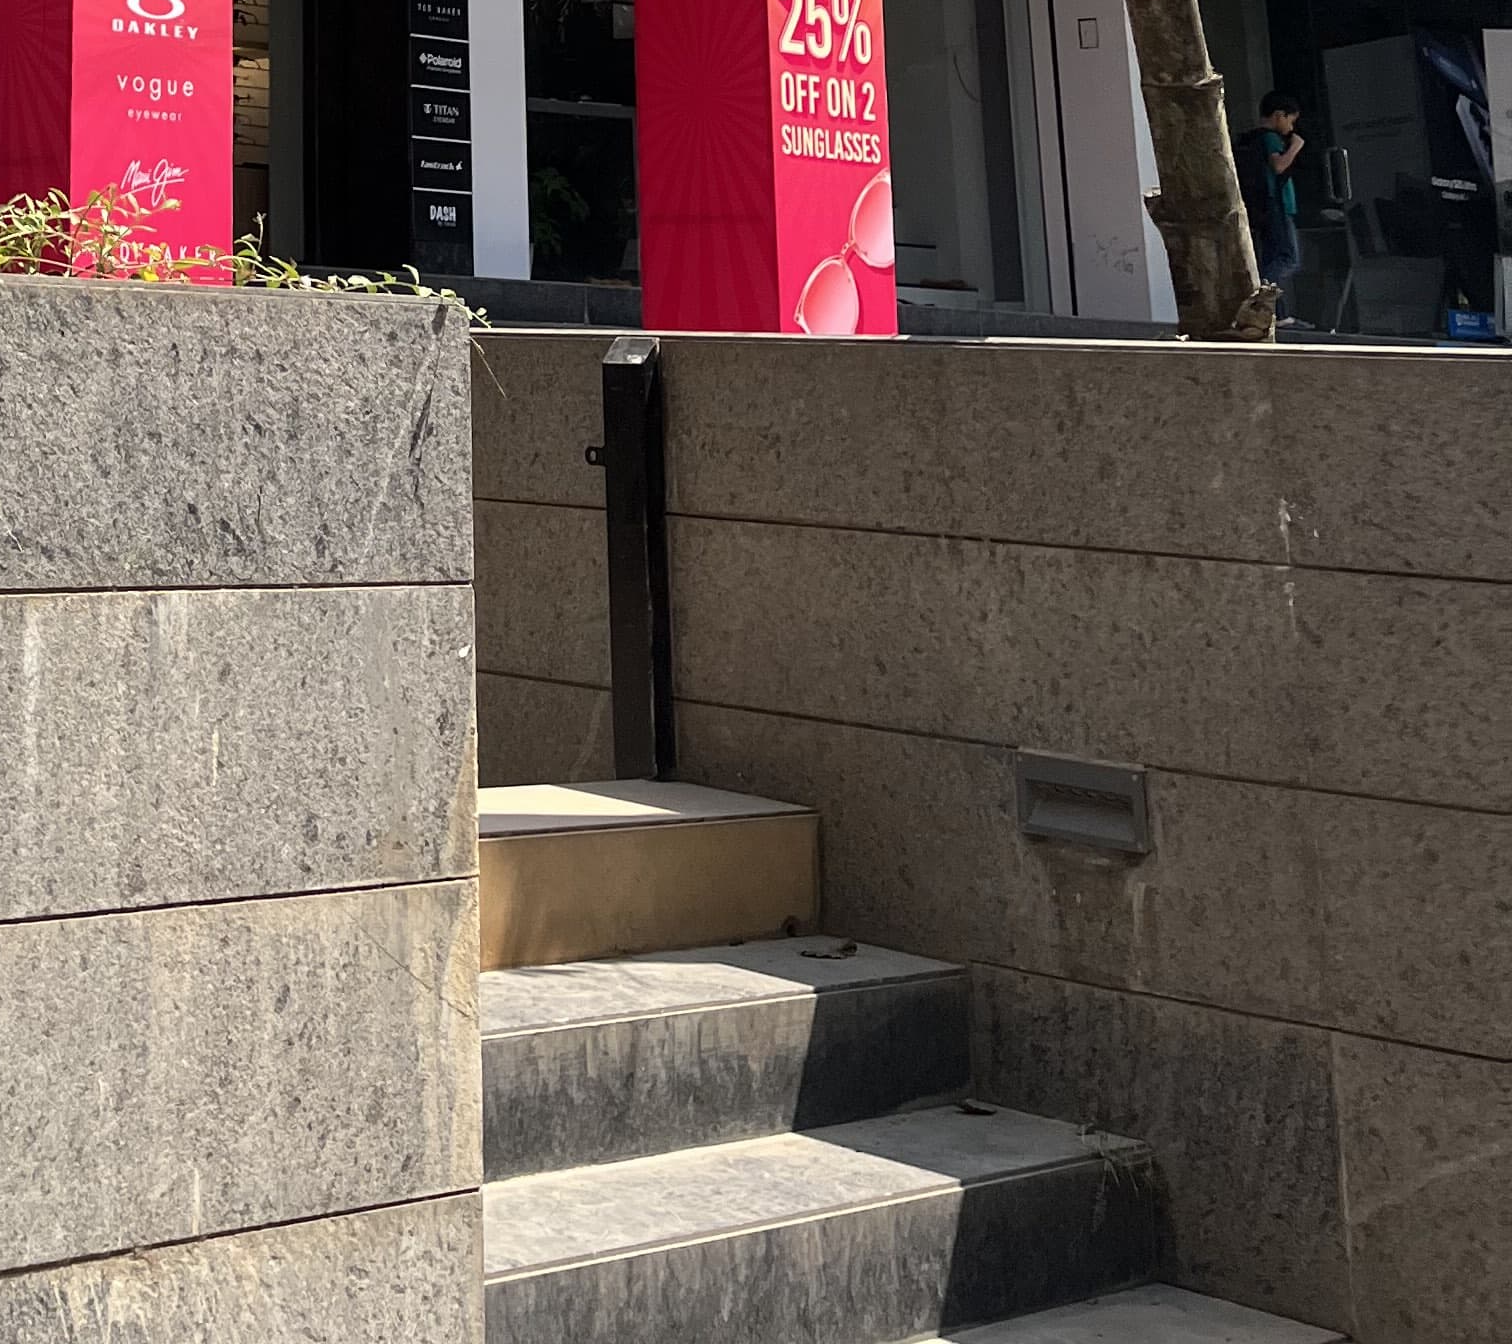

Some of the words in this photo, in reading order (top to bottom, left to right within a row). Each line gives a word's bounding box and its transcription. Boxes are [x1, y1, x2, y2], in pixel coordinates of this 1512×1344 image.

[112, 18, 199, 40] OAKLEY
[426, 53, 462, 68] Polaroid
[116, 74, 195, 101] vogue
[780, 71, 820, 115] OFF
[827, 78, 857, 120] ON
[861, 81, 877, 122] 2
[127, 108, 182, 122] eyewear
[432, 103, 460, 117] TITAN
[781, 124, 881, 165] SUNGLASSES
[429, 205, 457, 222] DASH
